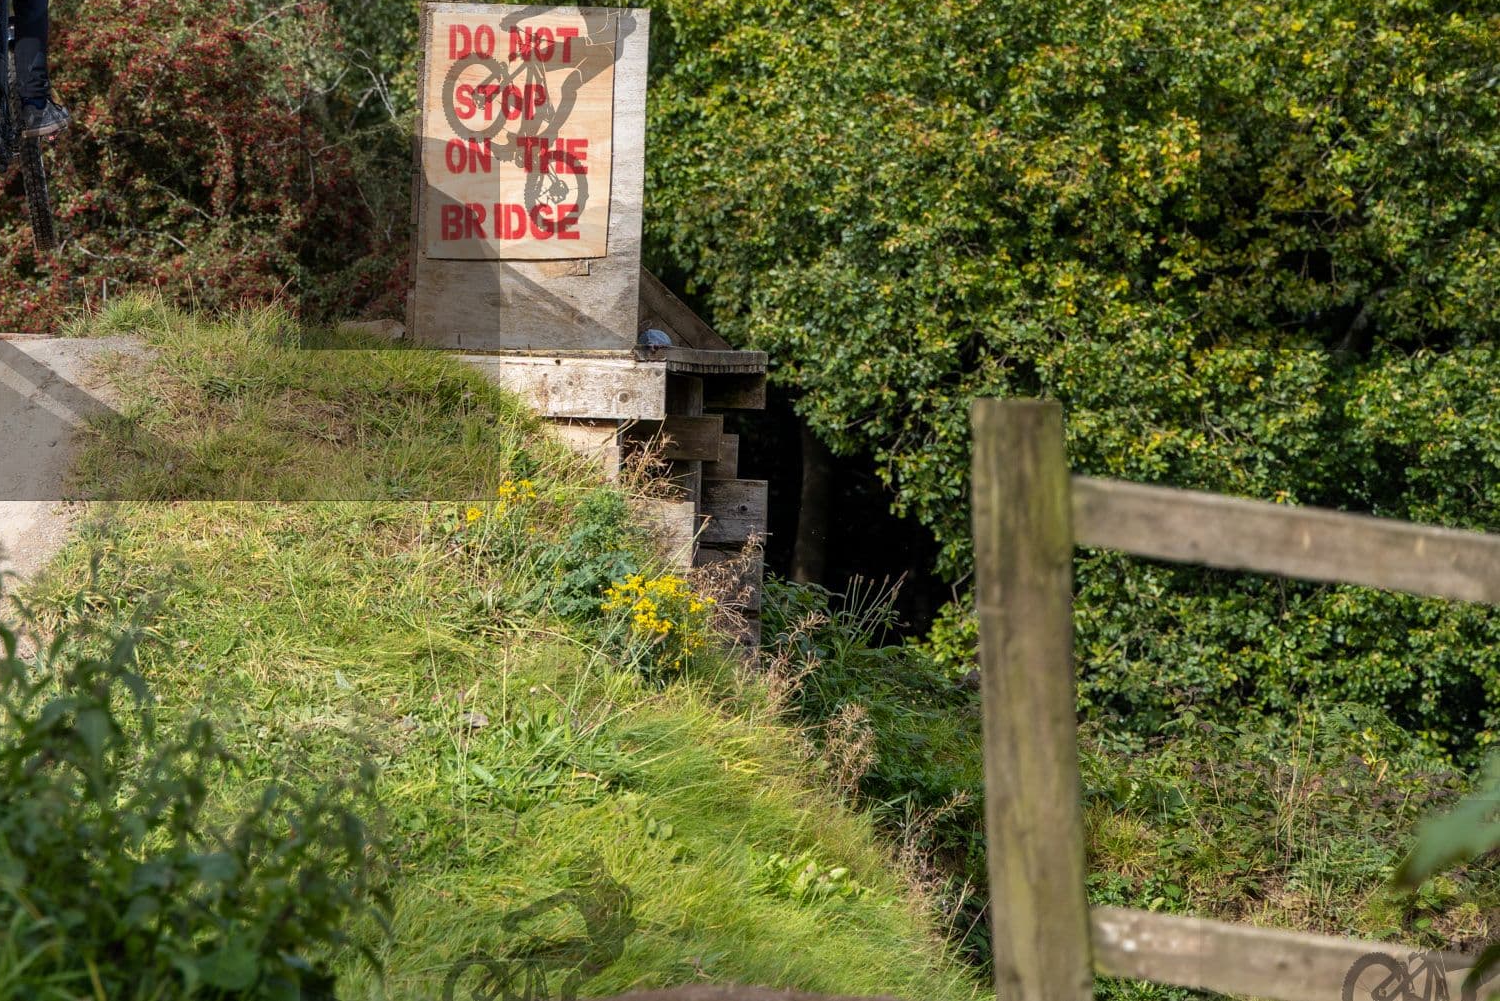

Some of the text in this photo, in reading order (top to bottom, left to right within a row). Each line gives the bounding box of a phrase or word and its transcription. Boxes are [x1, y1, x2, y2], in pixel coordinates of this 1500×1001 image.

[449, 24, 578, 63] DO NOT
[454, 84, 546, 120] STOP
[445, 138, 588, 174] ON THE
[441, 203, 580, 240] BRIDGE
